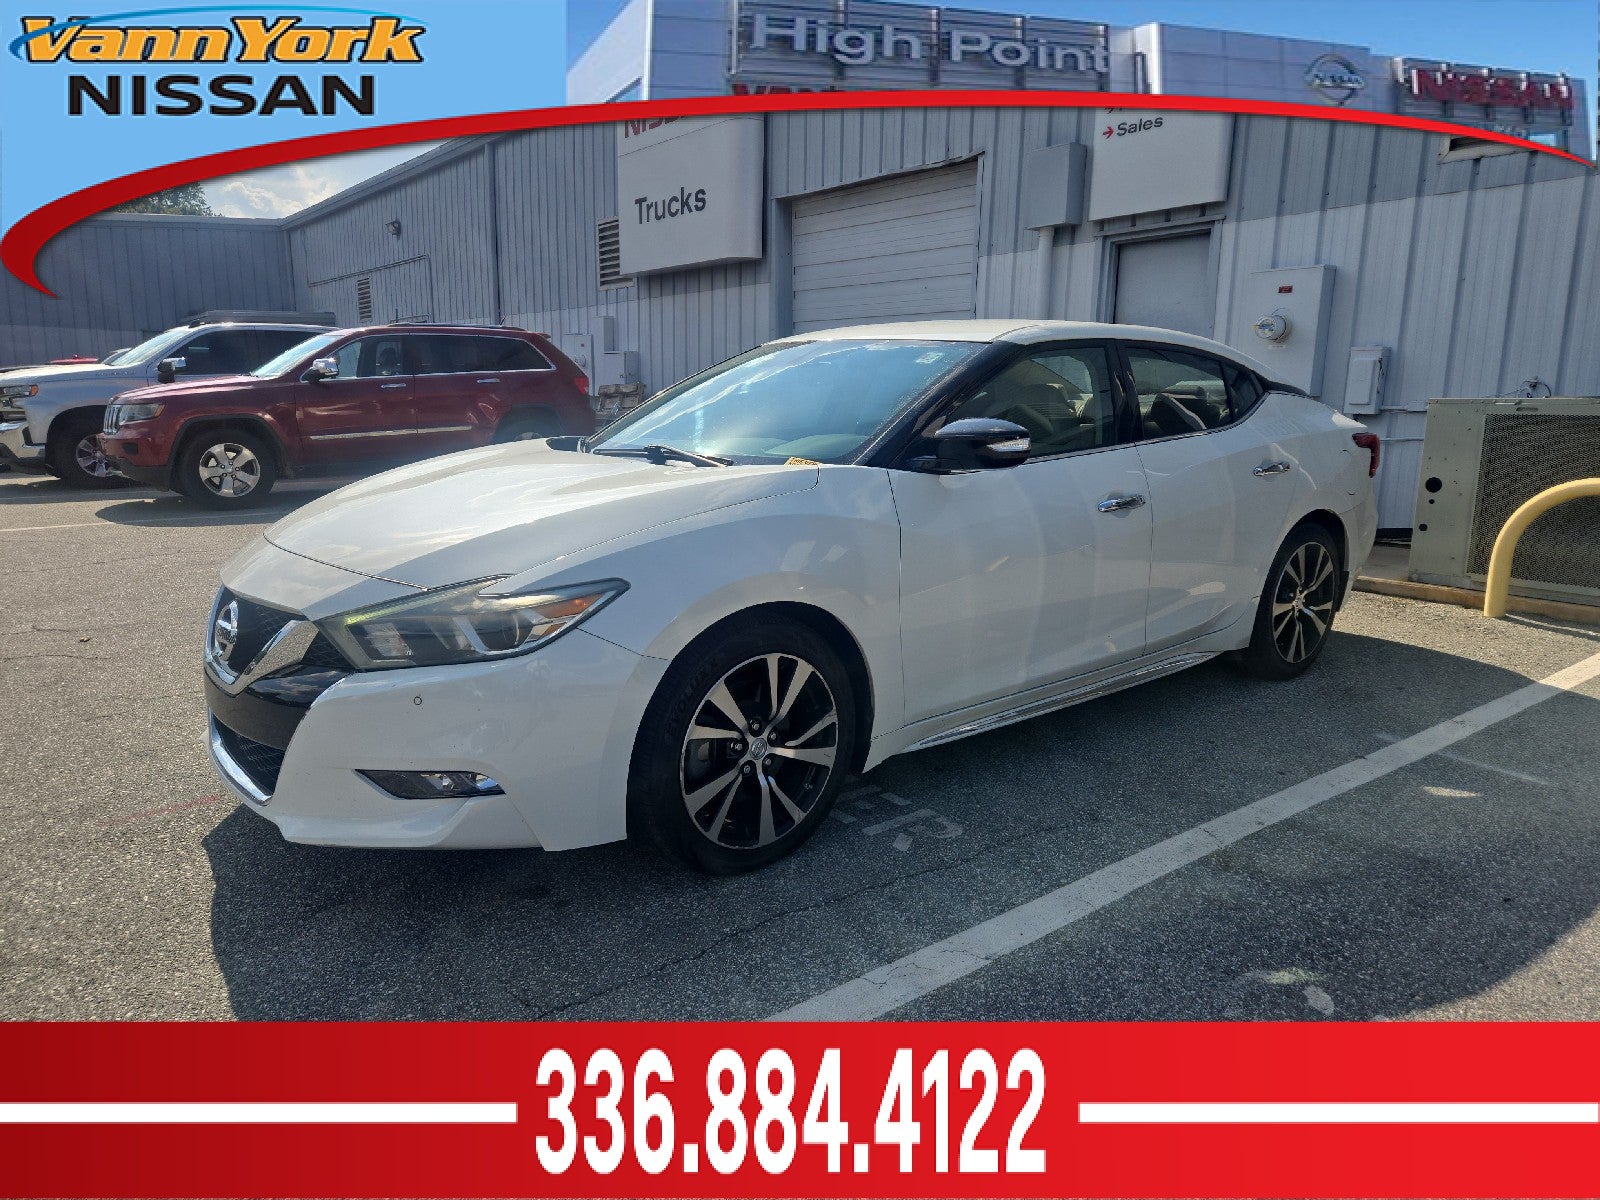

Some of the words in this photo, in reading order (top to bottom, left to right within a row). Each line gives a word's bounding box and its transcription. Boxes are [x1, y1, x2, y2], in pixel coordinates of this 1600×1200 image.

[751, 13, 921, 65] High
[951, 29, 1109, 73] Point
[1116, 116, 1164, 136] Sales
[634, 186, 707, 224] Trucks
